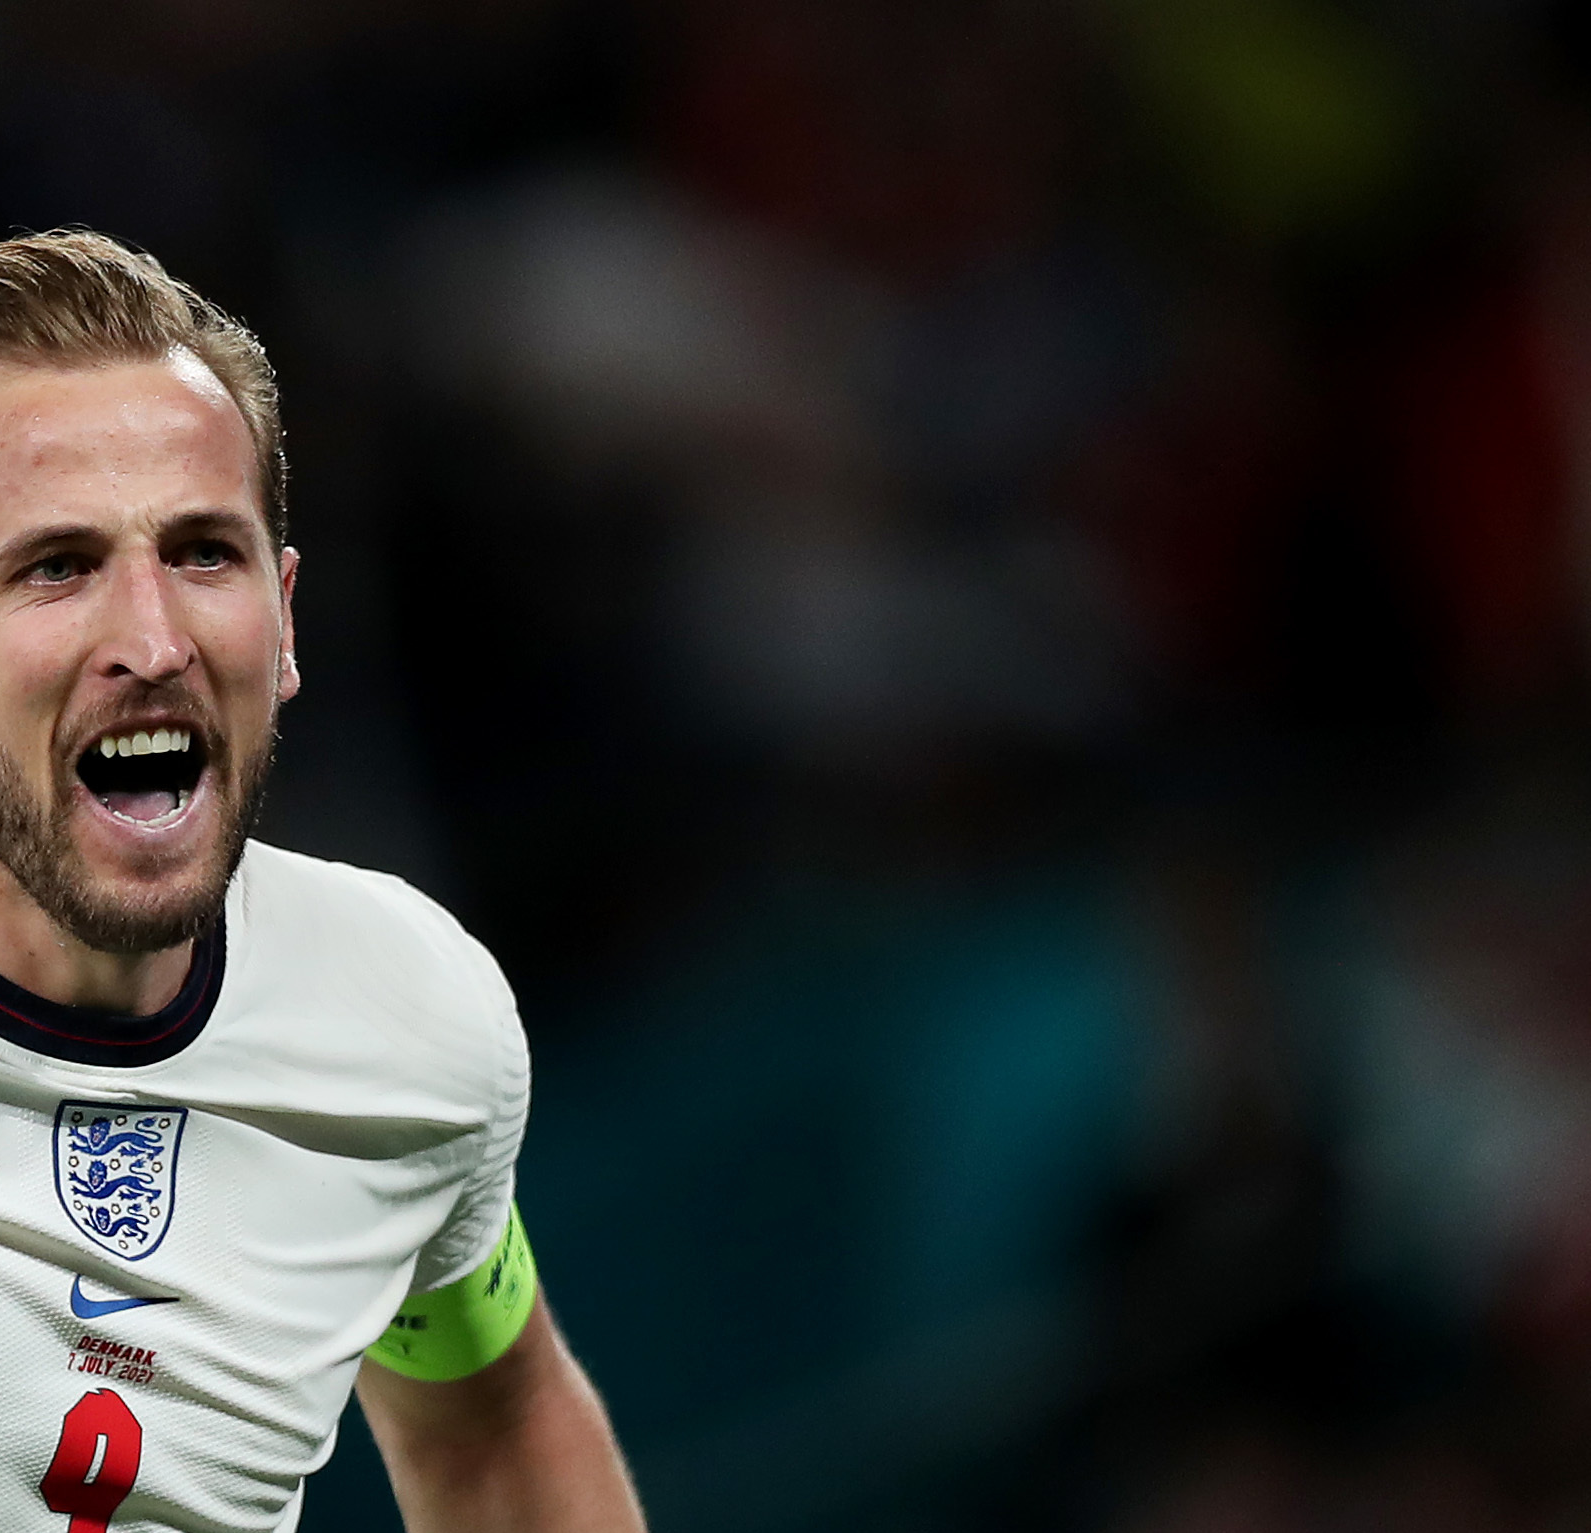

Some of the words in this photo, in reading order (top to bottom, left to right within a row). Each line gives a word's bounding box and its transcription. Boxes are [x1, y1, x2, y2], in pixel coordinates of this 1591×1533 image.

[77, 1335, 157, 1366] DENMARK
[67, 1352, 76, 1370] 7
[78, 1355, 117, 1376] JULY
[118, 1365, 155, 1384] 2021
